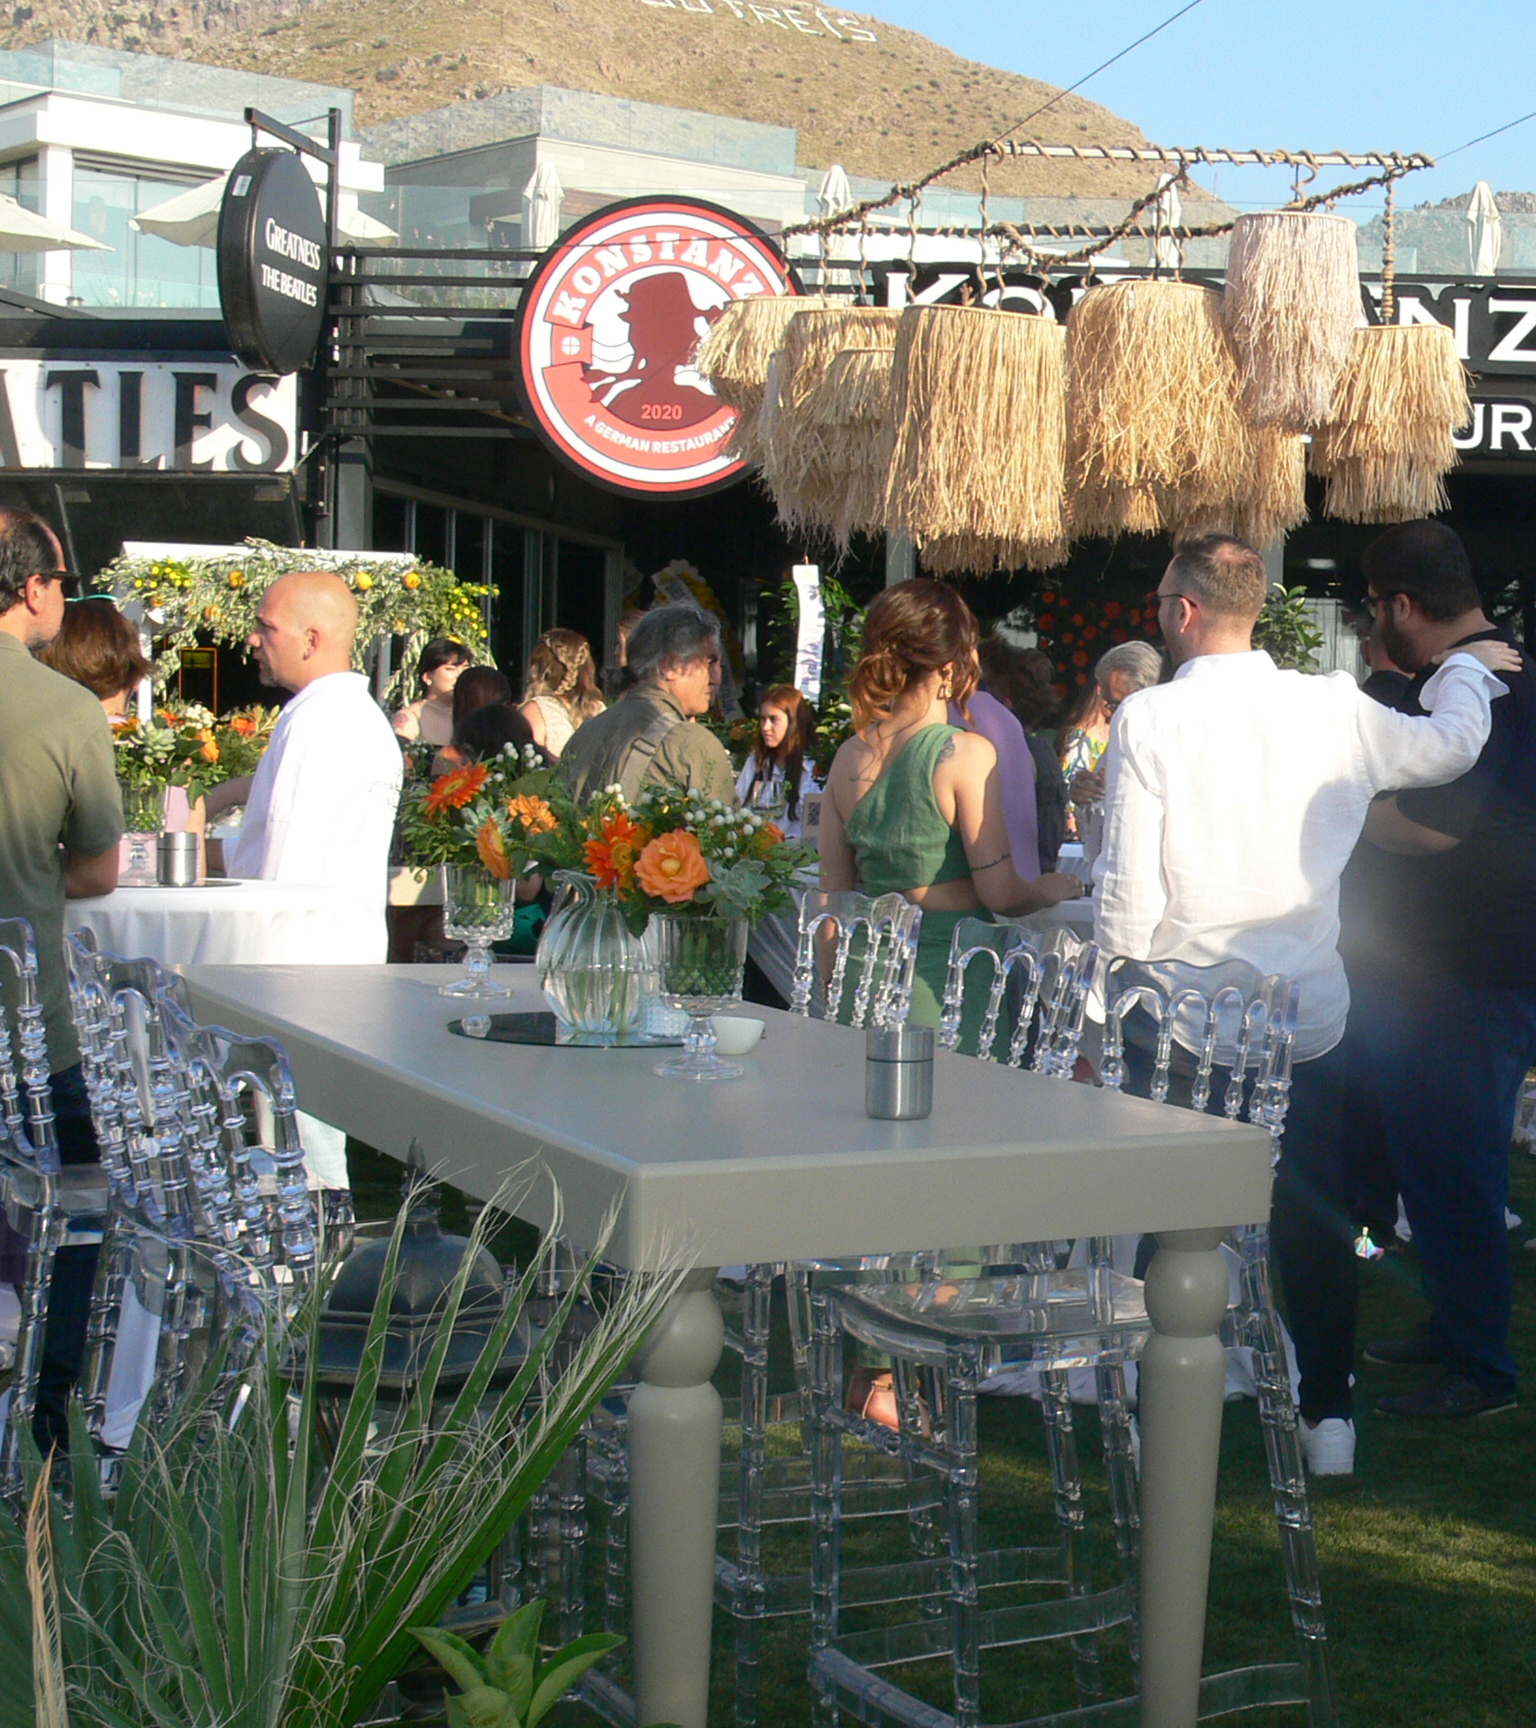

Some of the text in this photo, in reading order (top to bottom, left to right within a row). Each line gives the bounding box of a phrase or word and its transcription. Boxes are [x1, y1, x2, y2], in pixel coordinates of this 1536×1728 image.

[265, 217, 321, 271] GREATNESS
[261, 263, 318, 307] THE BEATLES
[641, 403, 683, 420] 2020
[584, 415, 736, 454] A GERMAN RESTAURANT
